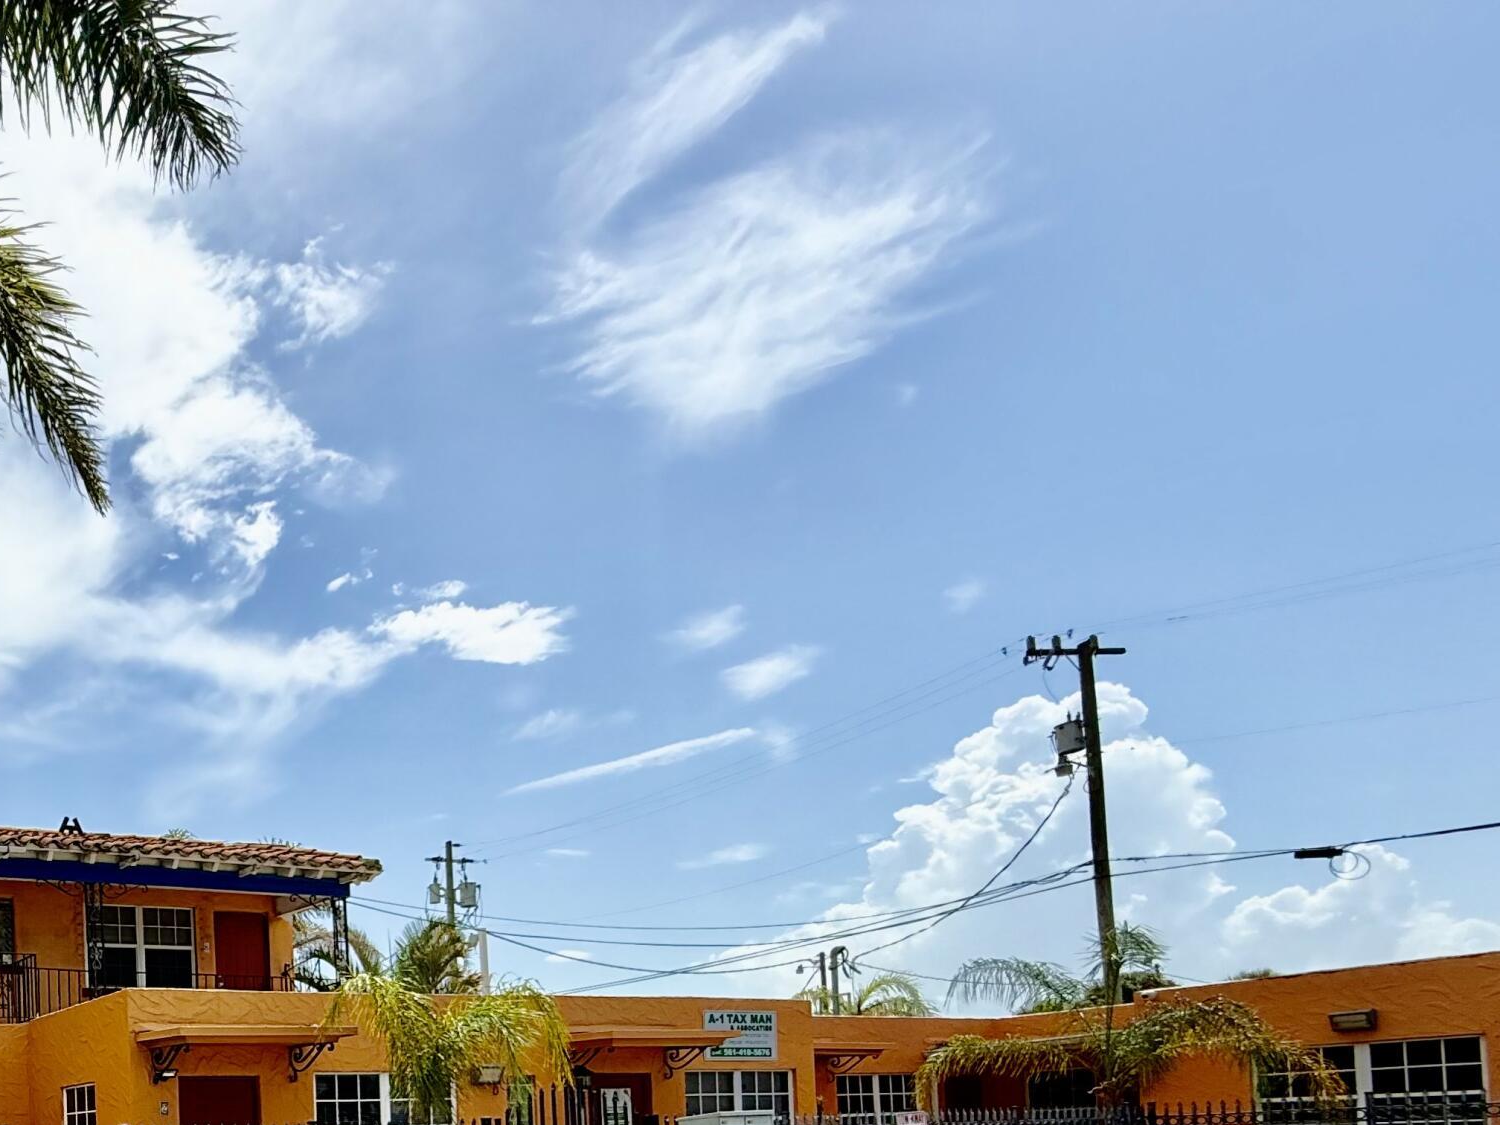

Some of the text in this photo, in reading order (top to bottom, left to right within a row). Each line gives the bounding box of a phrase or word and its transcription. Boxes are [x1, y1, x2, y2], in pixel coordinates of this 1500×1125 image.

[708, 1013, 772, 1024] A-1 TAX MAN
